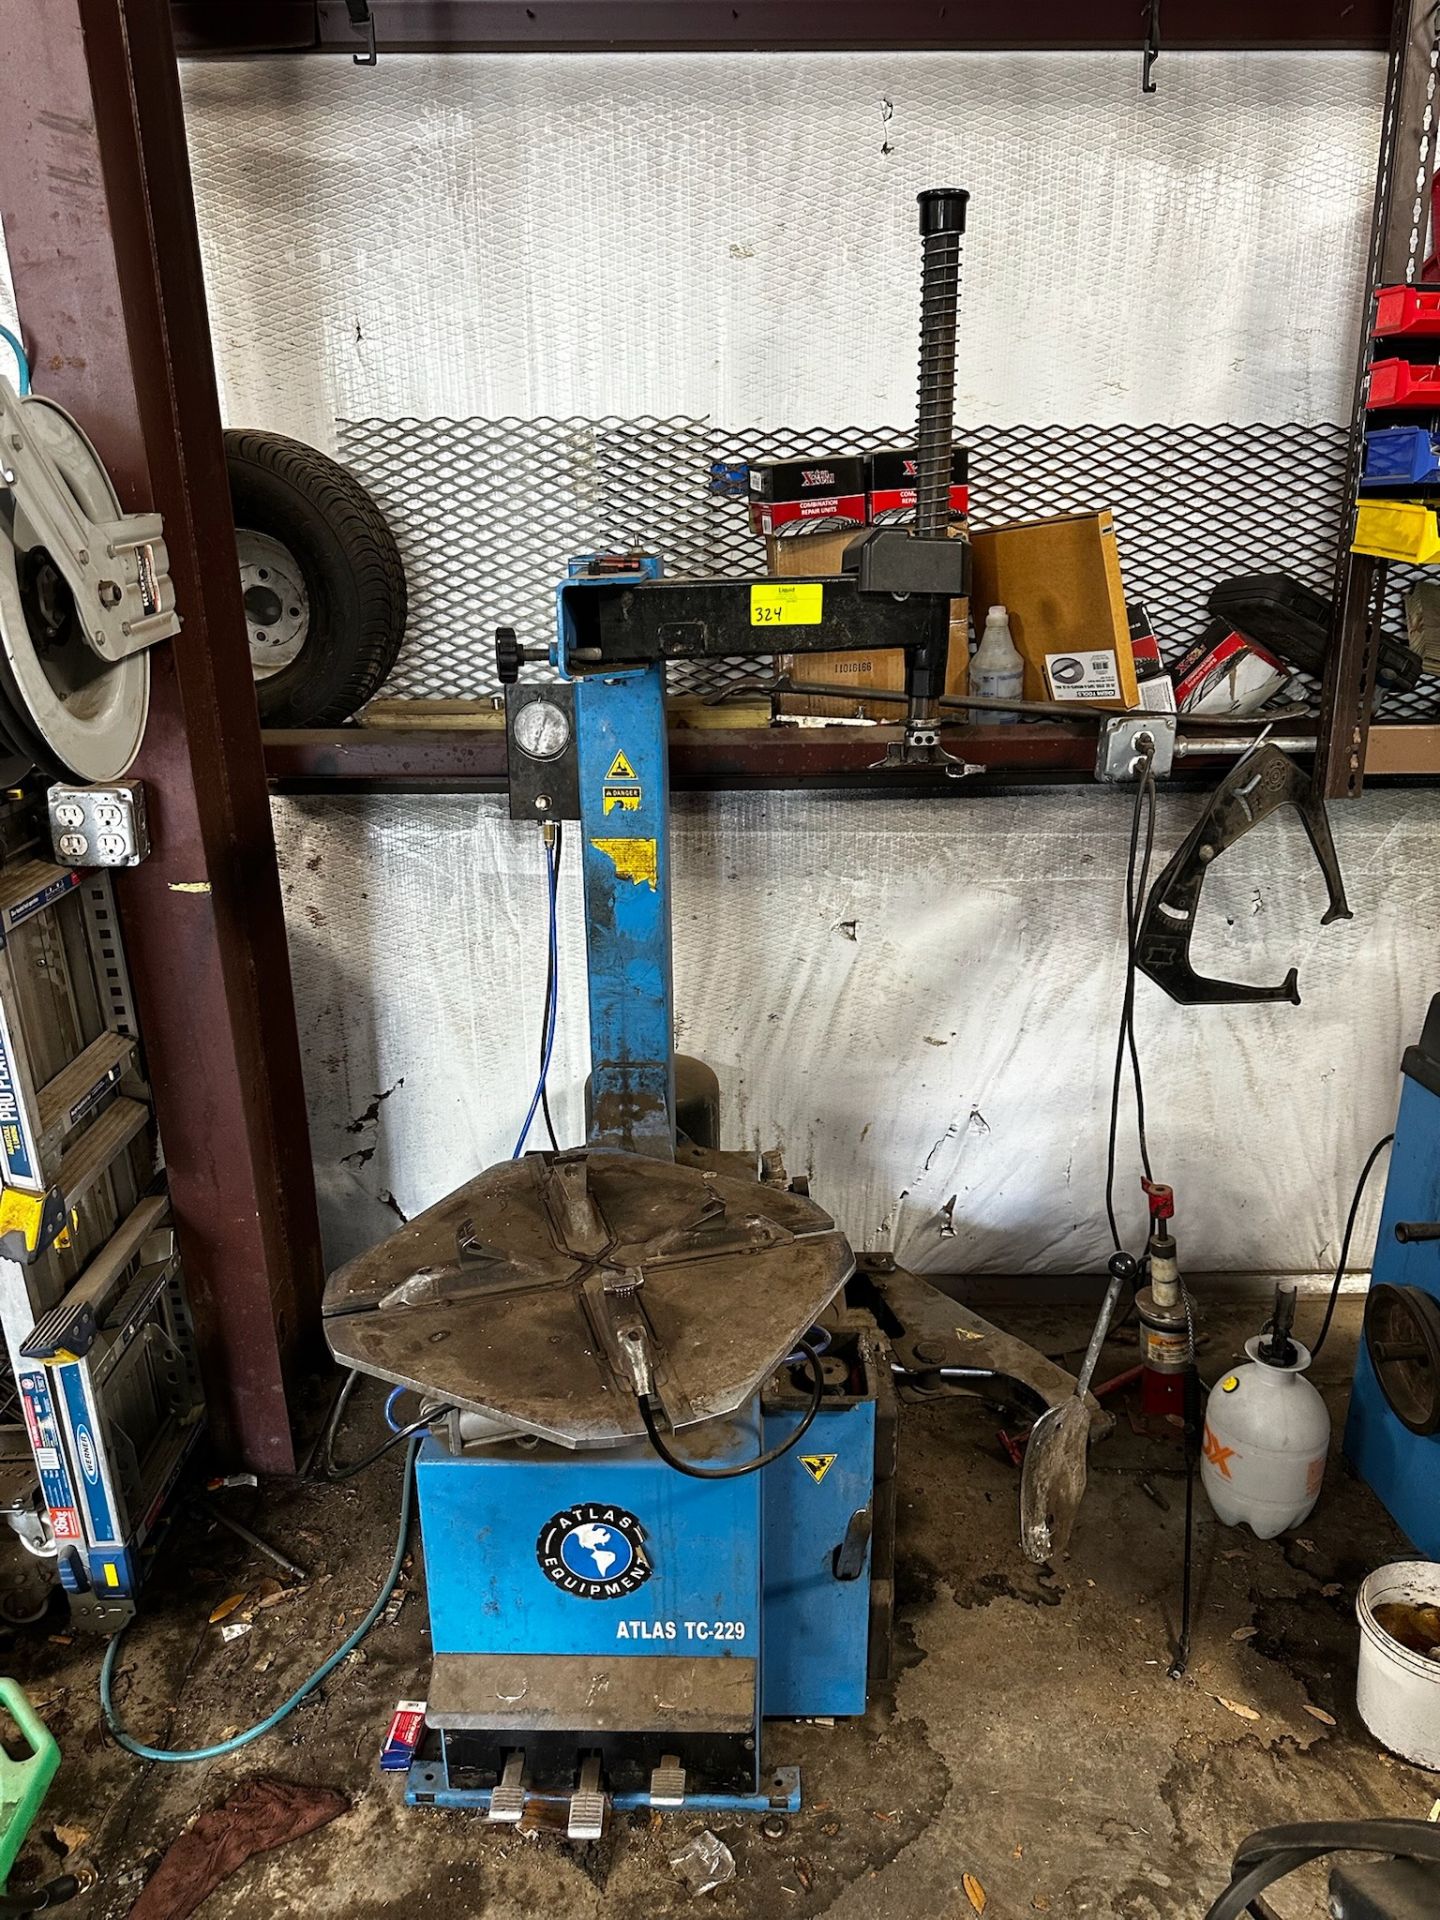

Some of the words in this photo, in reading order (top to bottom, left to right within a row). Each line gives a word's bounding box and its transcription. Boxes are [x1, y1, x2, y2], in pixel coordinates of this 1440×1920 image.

[799, 500, 838, 508] COMBINATION
[755, 606, 782, 622] 324
[80, 1436, 94, 1472] WERNER
[559, 1508, 632, 1529] ATLAS
[544, 1557, 646, 1595] EQUIPMENT
[616, 1620, 677, 1640] ATLAS
[684, 1620, 746, 1641] TC-229
